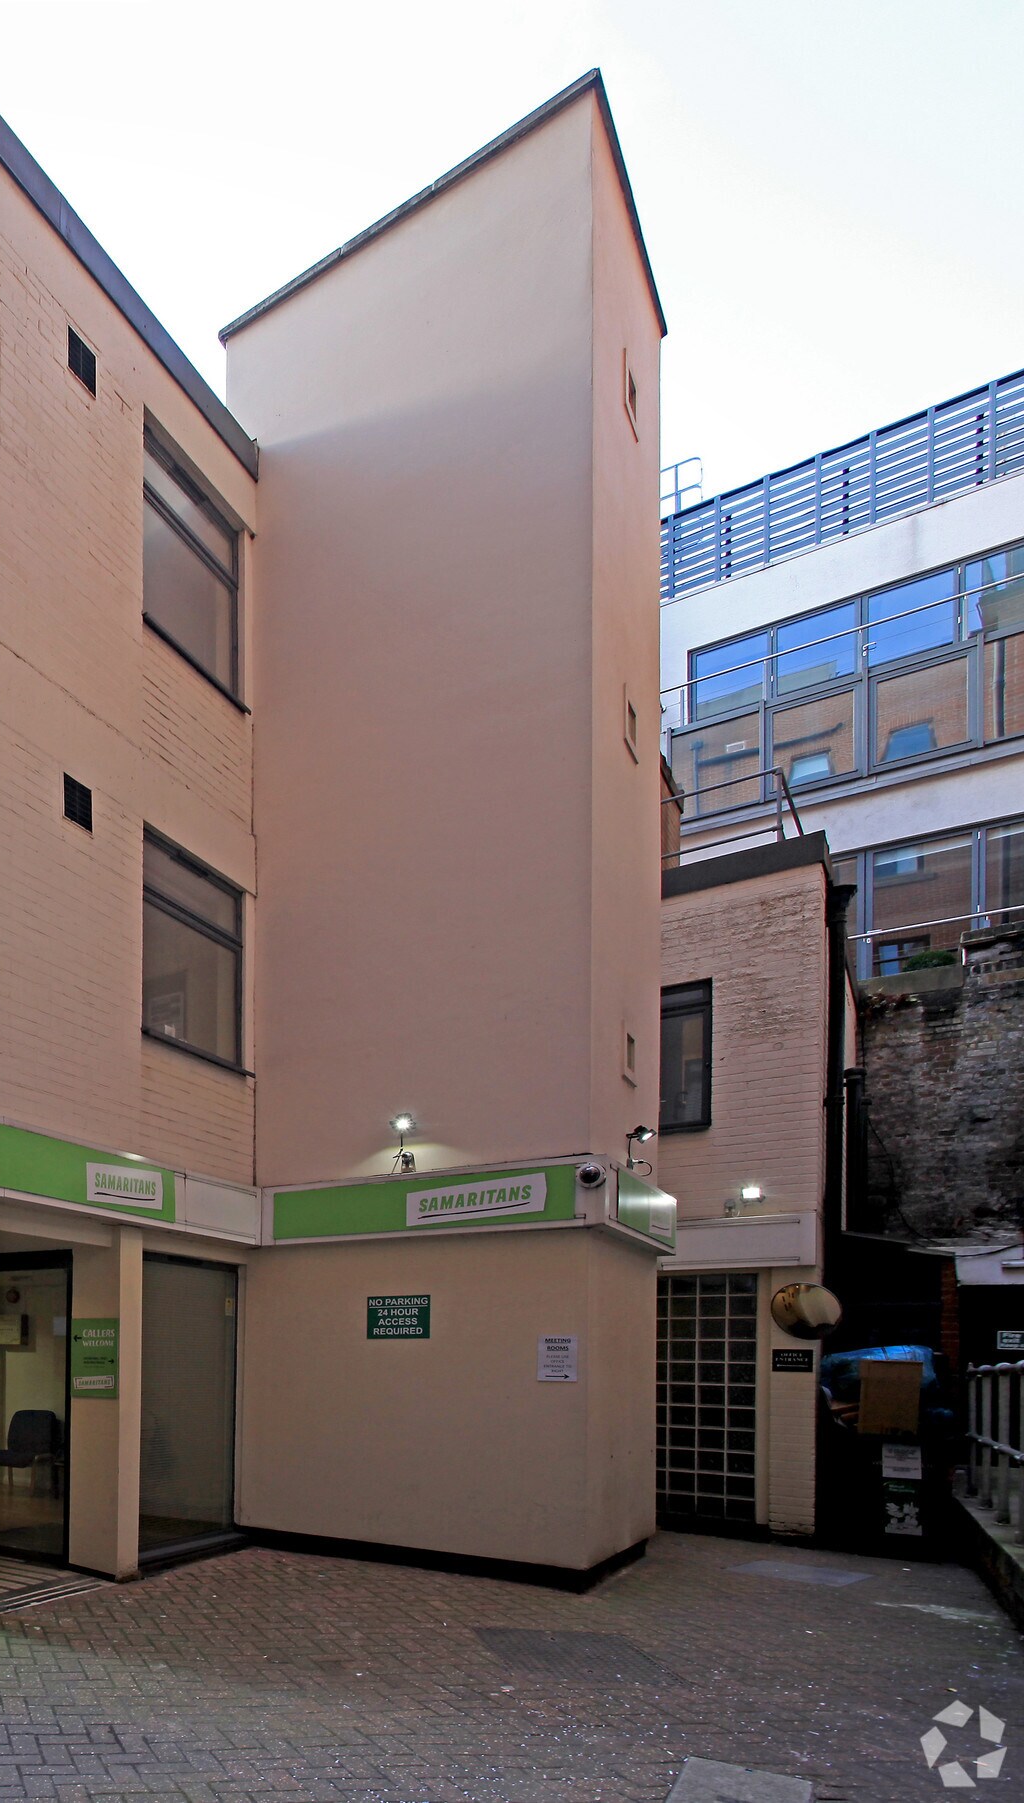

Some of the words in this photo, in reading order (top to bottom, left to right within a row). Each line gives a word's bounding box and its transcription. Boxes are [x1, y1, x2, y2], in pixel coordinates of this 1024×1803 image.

[94, 1172, 157, 1196] SAMARITANS
[418, 1184, 532, 1213] SAMARITANS
[385, 1297, 429, 1306] PARKING
[390, 1308, 419, 1316] HOUR
[378, 1317, 418, 1326] ACCESS
[82, 1328, 115, 1338] CALLERS
[373, 1327, 423, 1335] REQUIRED
